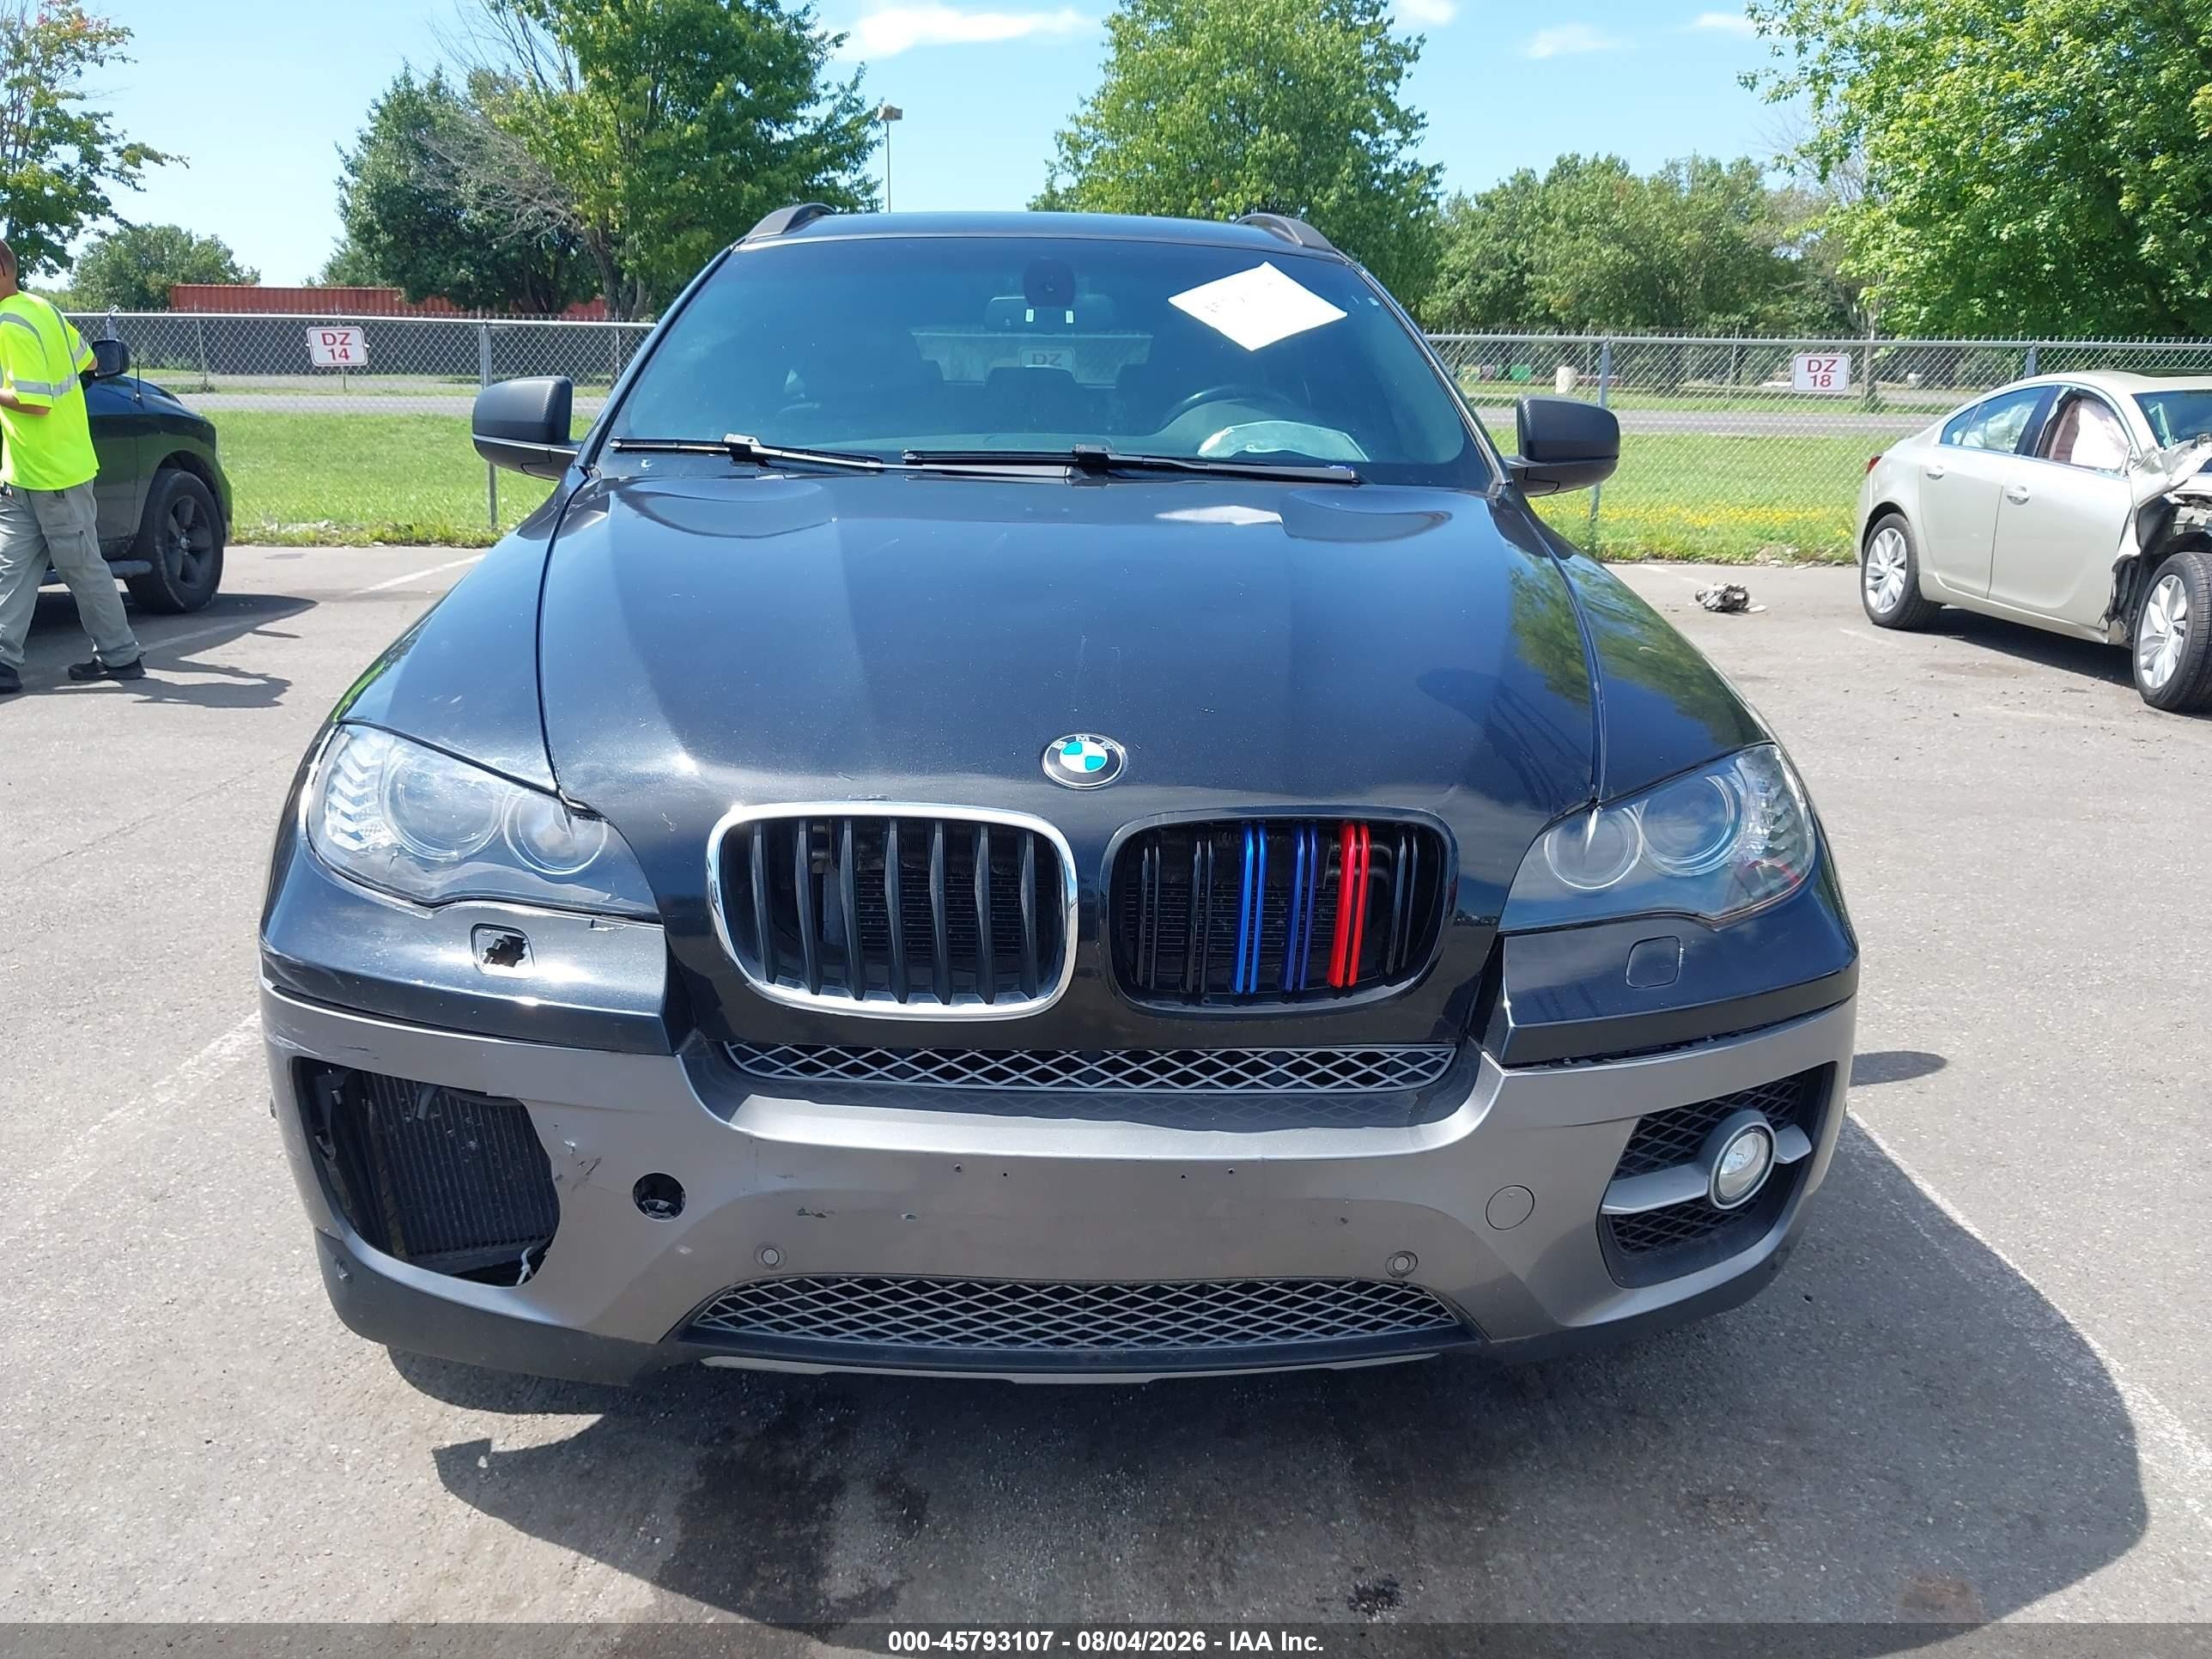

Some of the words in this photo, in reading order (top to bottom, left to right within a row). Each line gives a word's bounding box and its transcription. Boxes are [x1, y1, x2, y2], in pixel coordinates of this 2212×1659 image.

[321, 332, 352, 346] DZ
[327, 348, 350, 361] 14
[1032, 353, 1062, 367] DZ
[1807, 359, 1838, 373] DZ
[1809, 374, 1832, 387] 18
[1052, 735, 1115, 750] BMW
